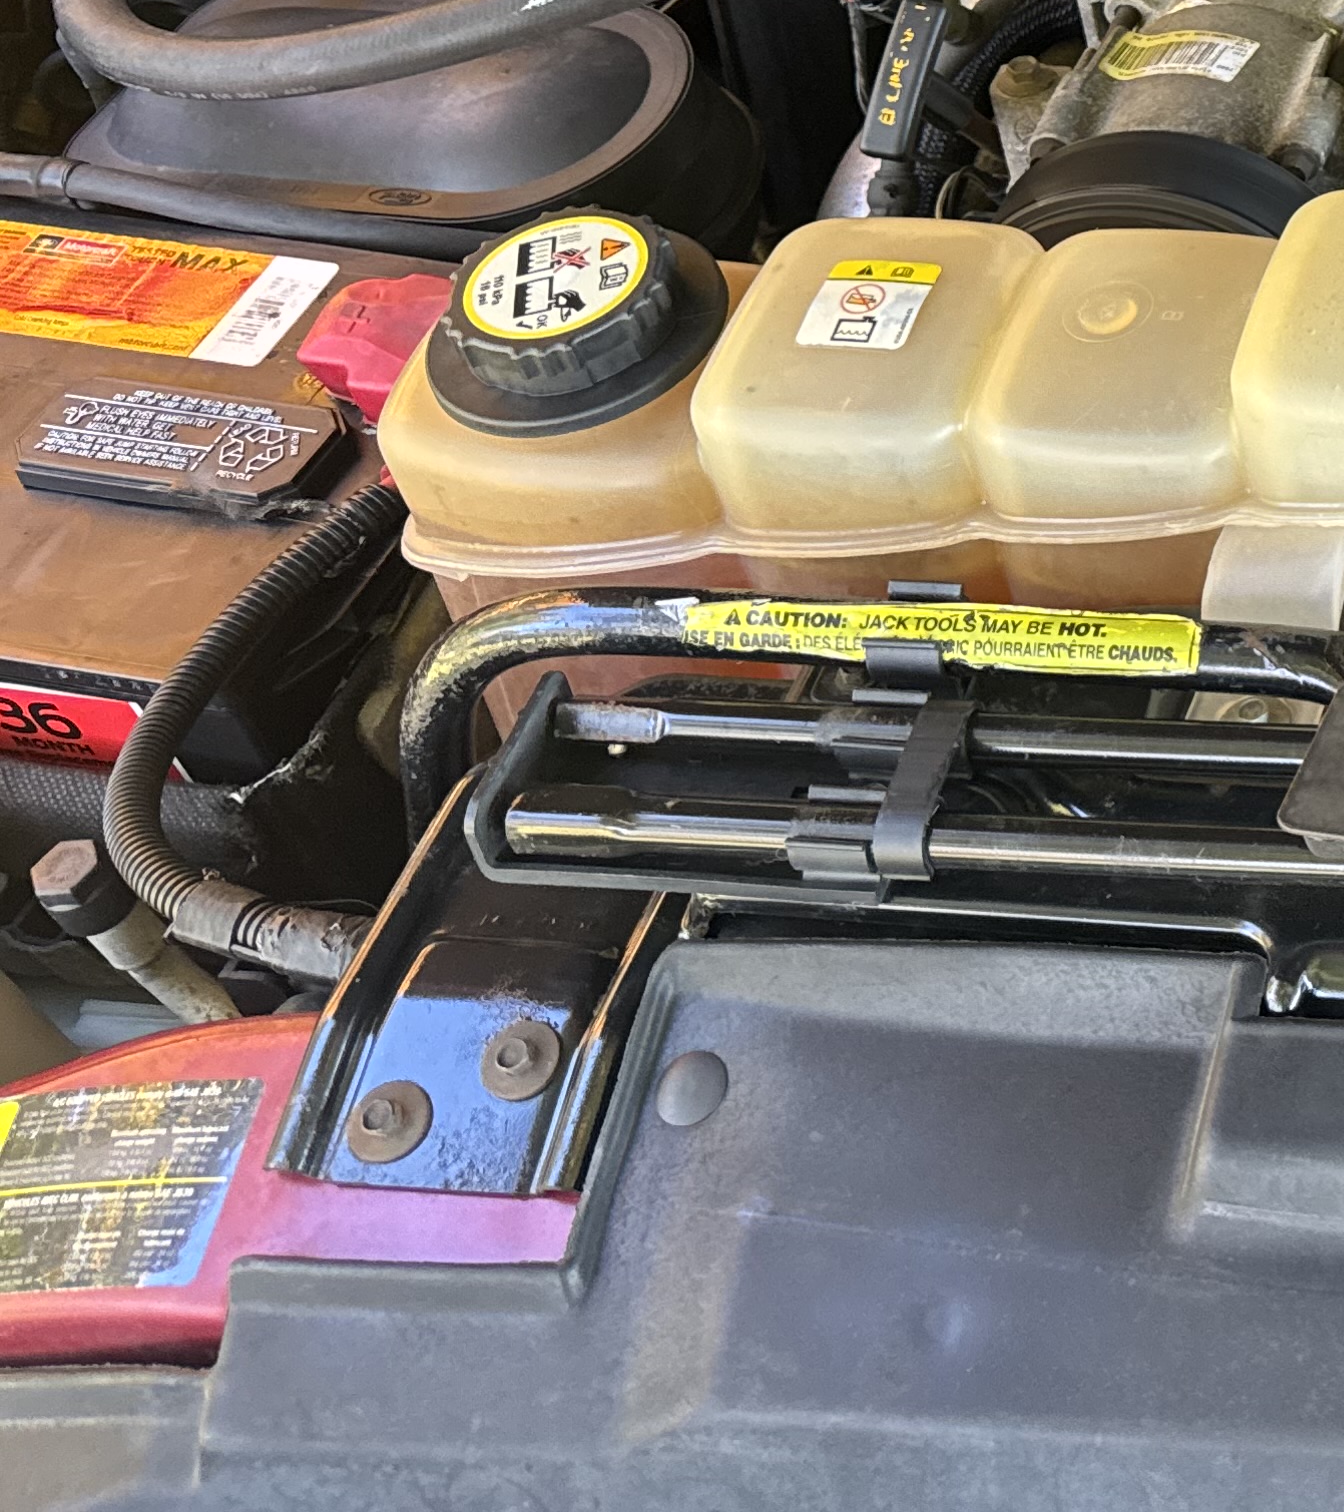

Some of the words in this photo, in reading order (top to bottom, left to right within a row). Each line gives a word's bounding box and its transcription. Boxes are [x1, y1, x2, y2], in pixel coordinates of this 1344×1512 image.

[63, 239, 118, 257] Motorcraft
[172, 251, 250, 272] MAX
[536, 315, 548, 329] OK
[93, 413, 116, 423] WITH
[152, 420, 174, 430] GET
[100, 405, 128, 416] FLUSH
[130, 408, 153, 419] EYES
[156, 411, 216, 428] IMMEDIATELY
[86, 421, 124, 433] MEDICAL
[127, 426, 150, 438] HELP
[151, 430, 176, 441] FAST
[746, 610, 848, 628] CAUTION:
[859, 614, 912, 630] JACK
[915, 613, 976, 633] TOOLS
[982, 618, 1023, 634] MAY
[1027, 621, 1053, 635] BE
[1058, 622, 1107, 637] HOT.
[714, 632, 734, 646] EN
[739, 632, 792, 649] GARDE
[804, 635, 831, 649] DES
[974, 639, 1066, 658] POURRAIENT
[12, 735, 95, 756] MONTH
